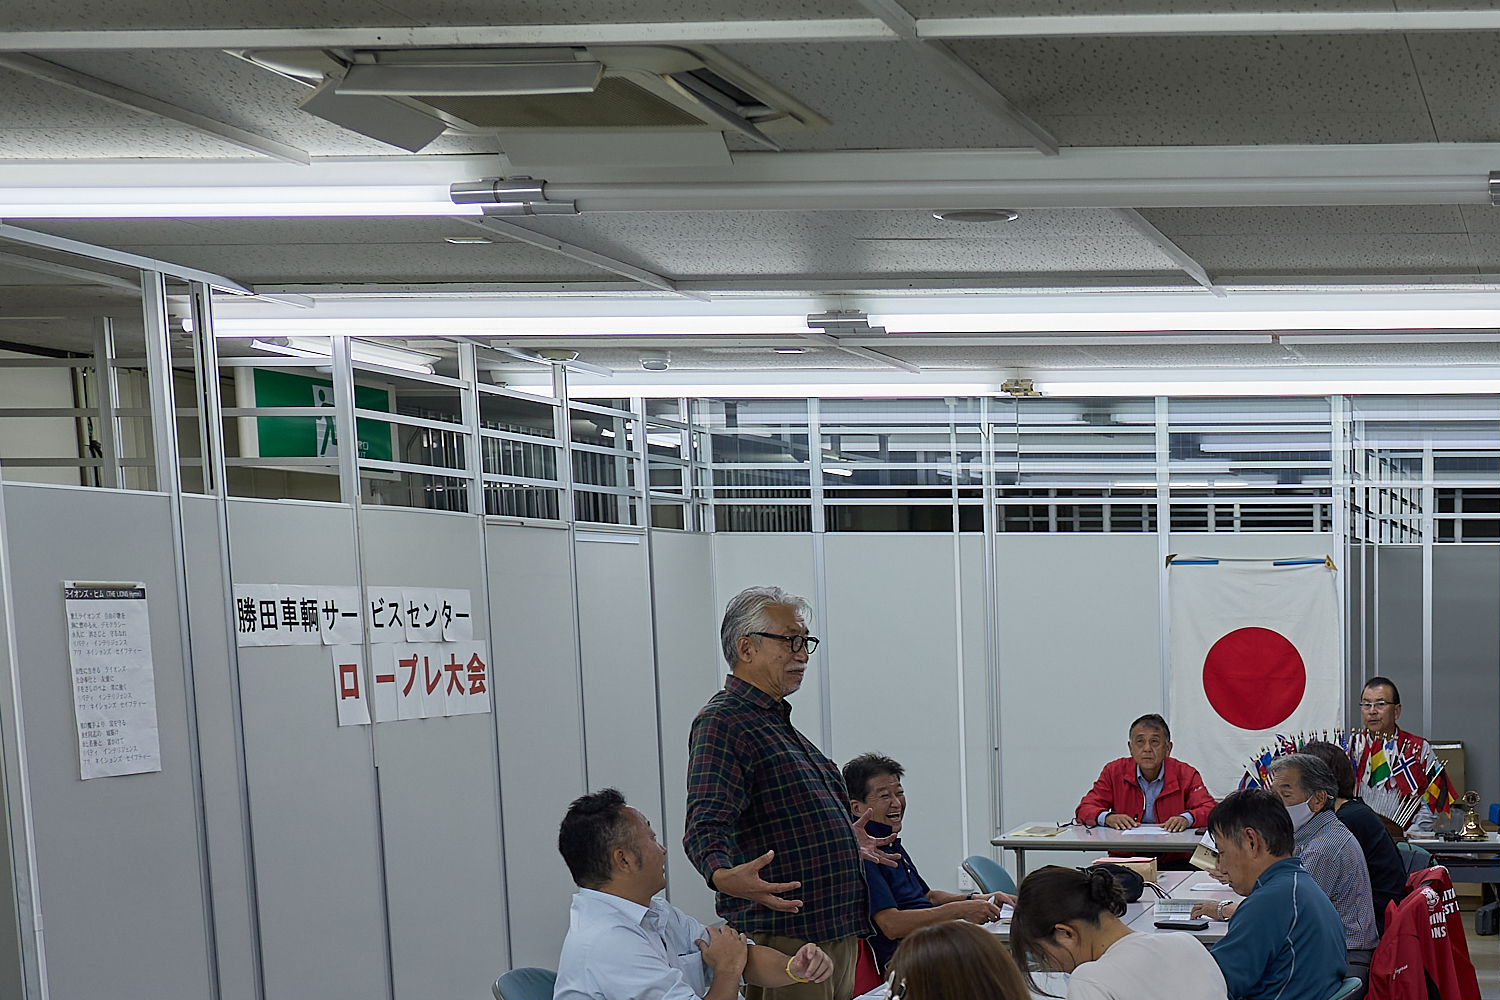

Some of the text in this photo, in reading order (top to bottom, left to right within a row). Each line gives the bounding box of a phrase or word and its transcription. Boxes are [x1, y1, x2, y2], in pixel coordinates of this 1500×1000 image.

[339, 652, 487, 700] ロープレ大会
